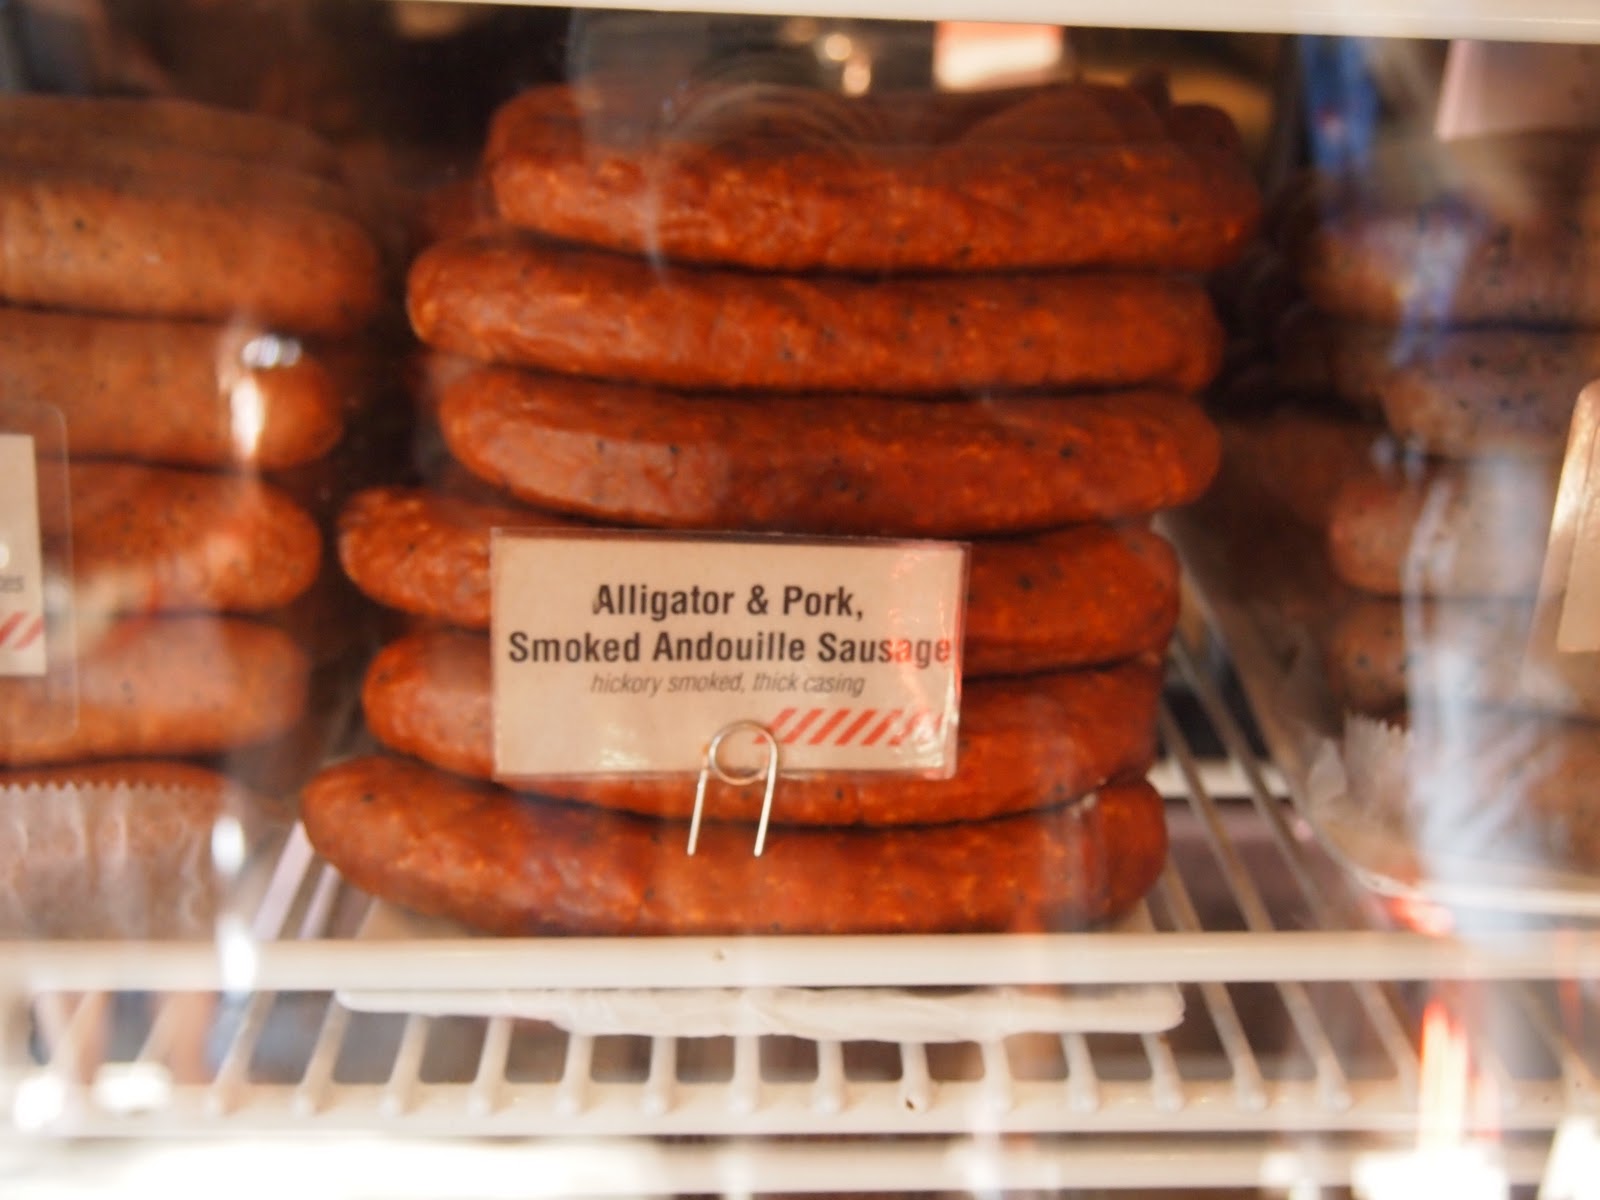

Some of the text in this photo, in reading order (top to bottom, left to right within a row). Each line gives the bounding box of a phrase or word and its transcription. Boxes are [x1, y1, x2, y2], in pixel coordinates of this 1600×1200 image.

[594, 584, 864, 621] Alligator & Pork,
[509, 631, 951, 668] Smoked Andouille Sausage
[591, 672, 866, 698] hickory smoked, thick casing
